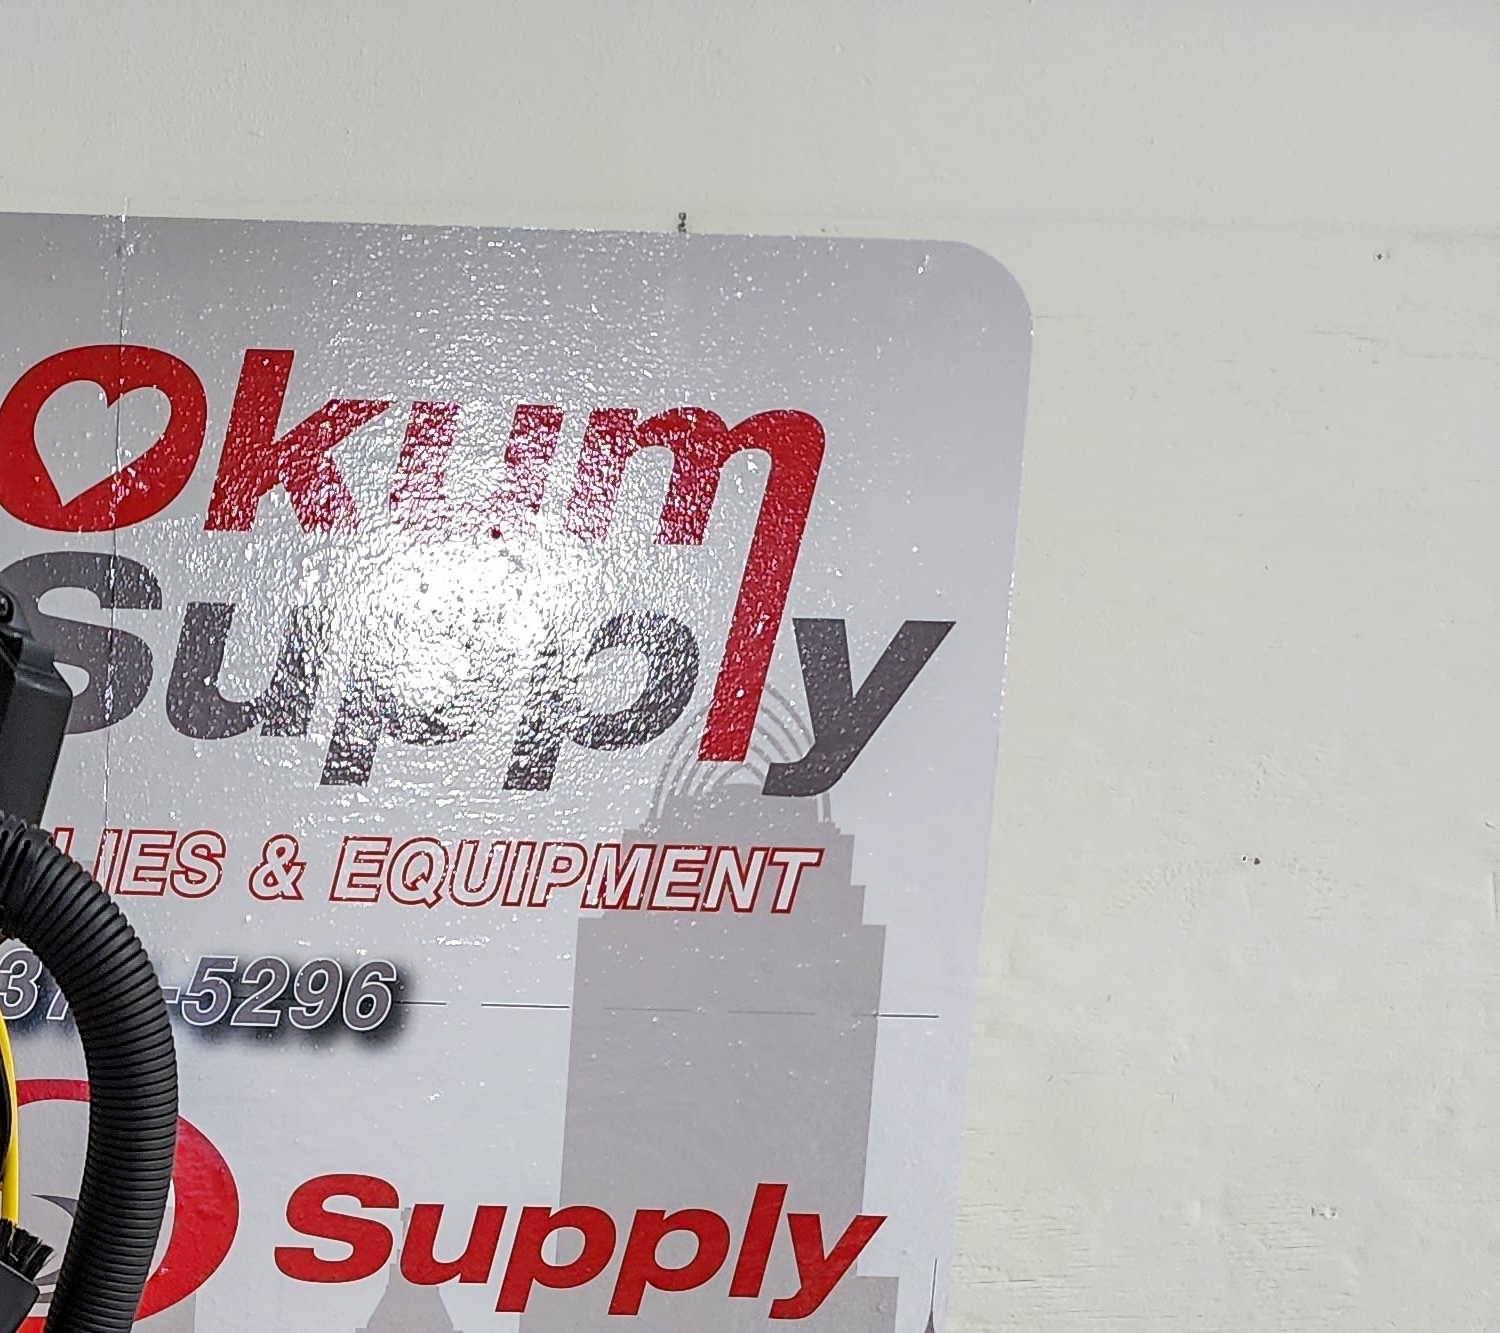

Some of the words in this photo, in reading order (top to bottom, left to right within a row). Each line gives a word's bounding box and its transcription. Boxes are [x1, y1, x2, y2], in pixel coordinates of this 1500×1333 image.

[248, 833, 307, 901] &
[328, 835, 825, 915] EQUIPMENT
[273, 1173, 888, 1320] Supply
